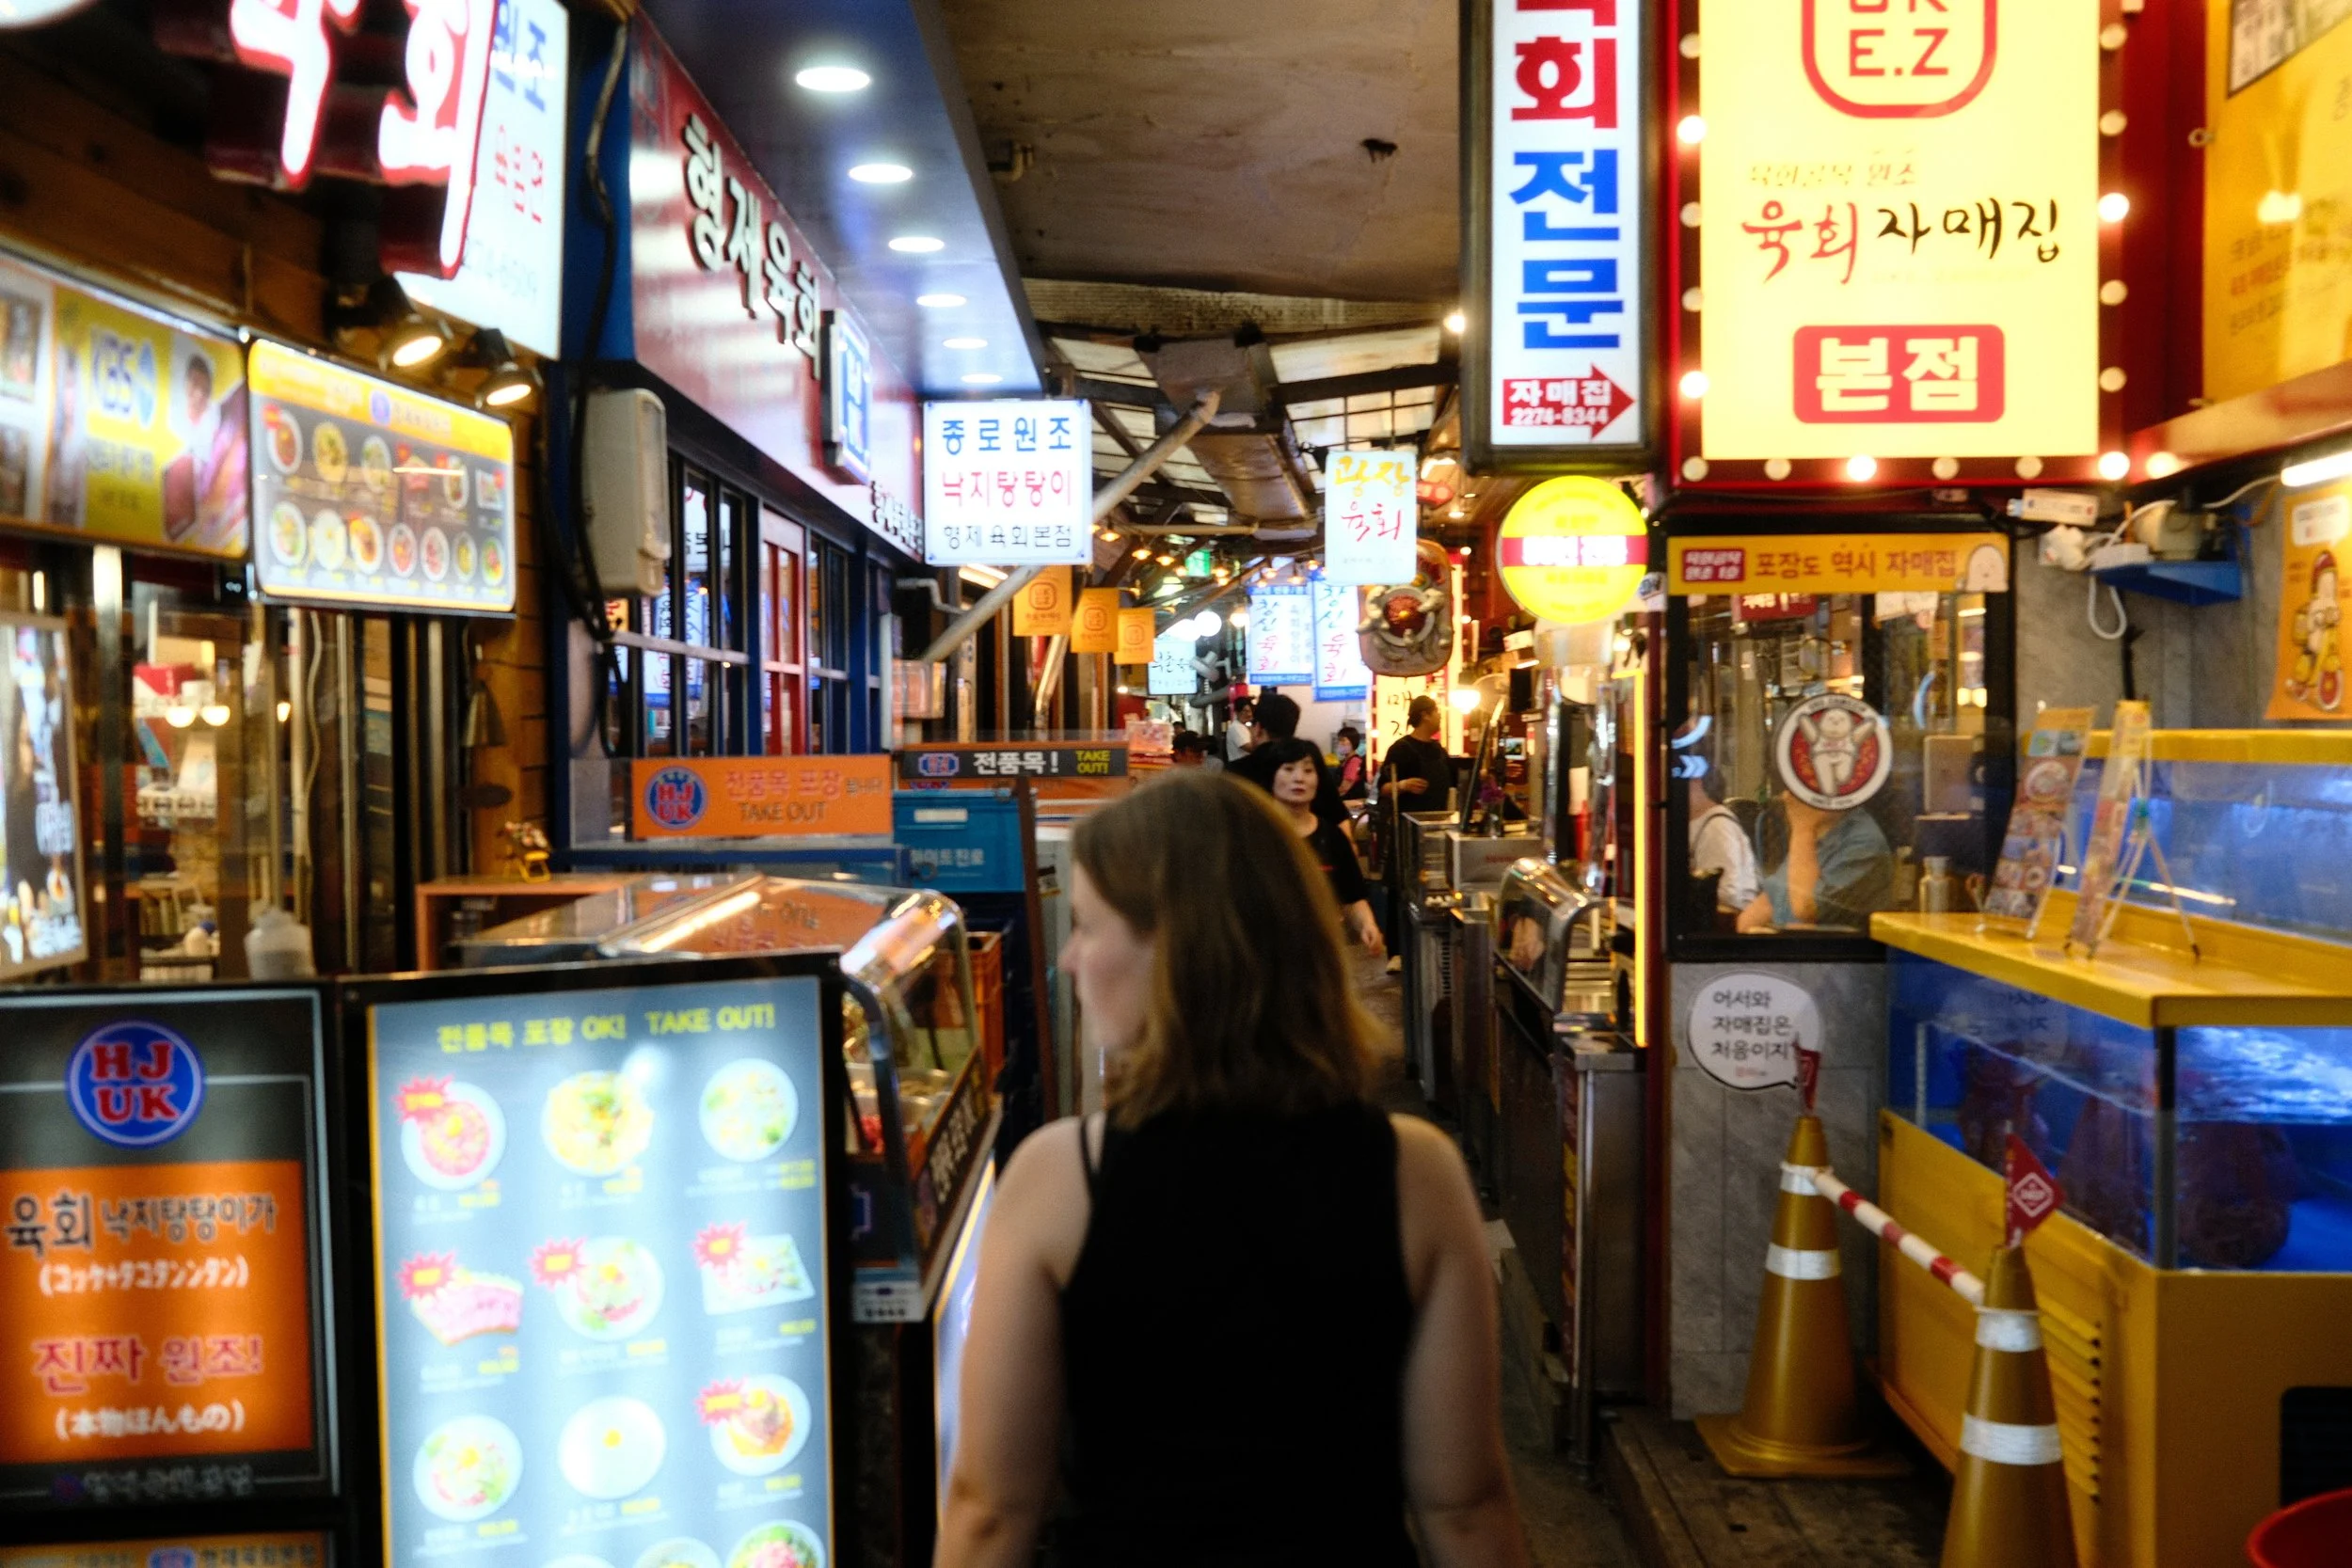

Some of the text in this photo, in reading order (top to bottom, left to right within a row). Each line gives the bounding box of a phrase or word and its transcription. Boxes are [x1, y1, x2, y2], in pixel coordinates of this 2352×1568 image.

[1849, 27, 1949, 77] E.Z
[1816, 336, 1979, 413] 본점
[1509, 379, 1612, 406] 자매집
[942, 470, 1072, 508] 낙지탕탕이
[1334, 455, 1411, 498] 광장
[1341, 500, 1402, 543] 육회
[1756, 549, 1957, 579] 포장도 역시 자매집
[1076, 750, 1111, 763] TAKE
[1077, 762, 1109, 774] OUT!
[799, 769, 842, 799] 포장
[739, 801, 826, 824] TAKE OUT
[1712, 990, 1771, 1007] 어서와
[645, 1007, 711, 1036] TAKE
[716, 1003, 776, 1031] OUT!
[1712, 1014, 1792, 1036] 자매집은
[91, 1040, 174, 1081] HJ
[96, 1085, 180, 1125] UK
[6, 1187, 278, 1258] 육회 낙지탕탕이가
[32, 1334, 263, 1396] 진짜 원조!
